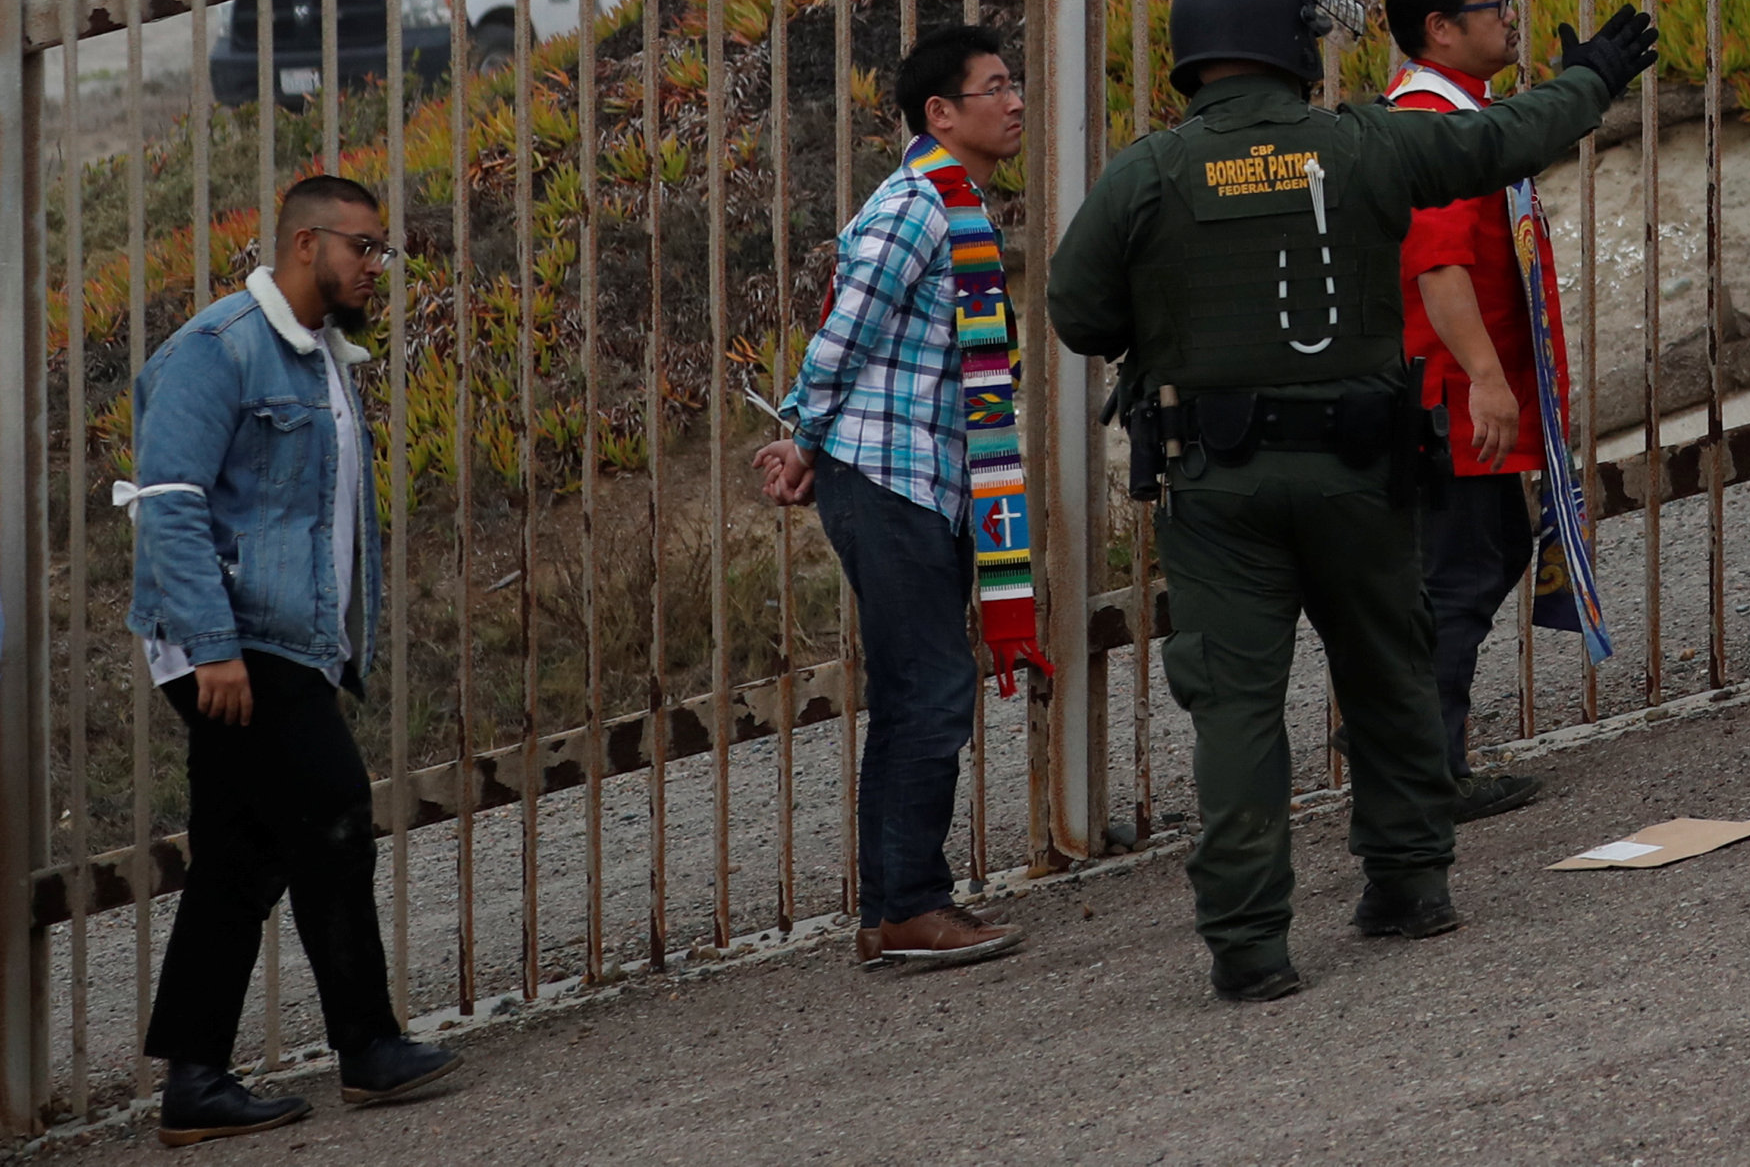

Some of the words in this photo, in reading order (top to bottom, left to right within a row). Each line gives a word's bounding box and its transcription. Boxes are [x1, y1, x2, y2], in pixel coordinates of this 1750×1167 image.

[1250, 145, 1275, 156] CBP
[1205, 158, 1266, 186] BORDER
[1218, 183, 1272, 197] FEDERAL
[1275, 178, 1310, 191] AGEN
